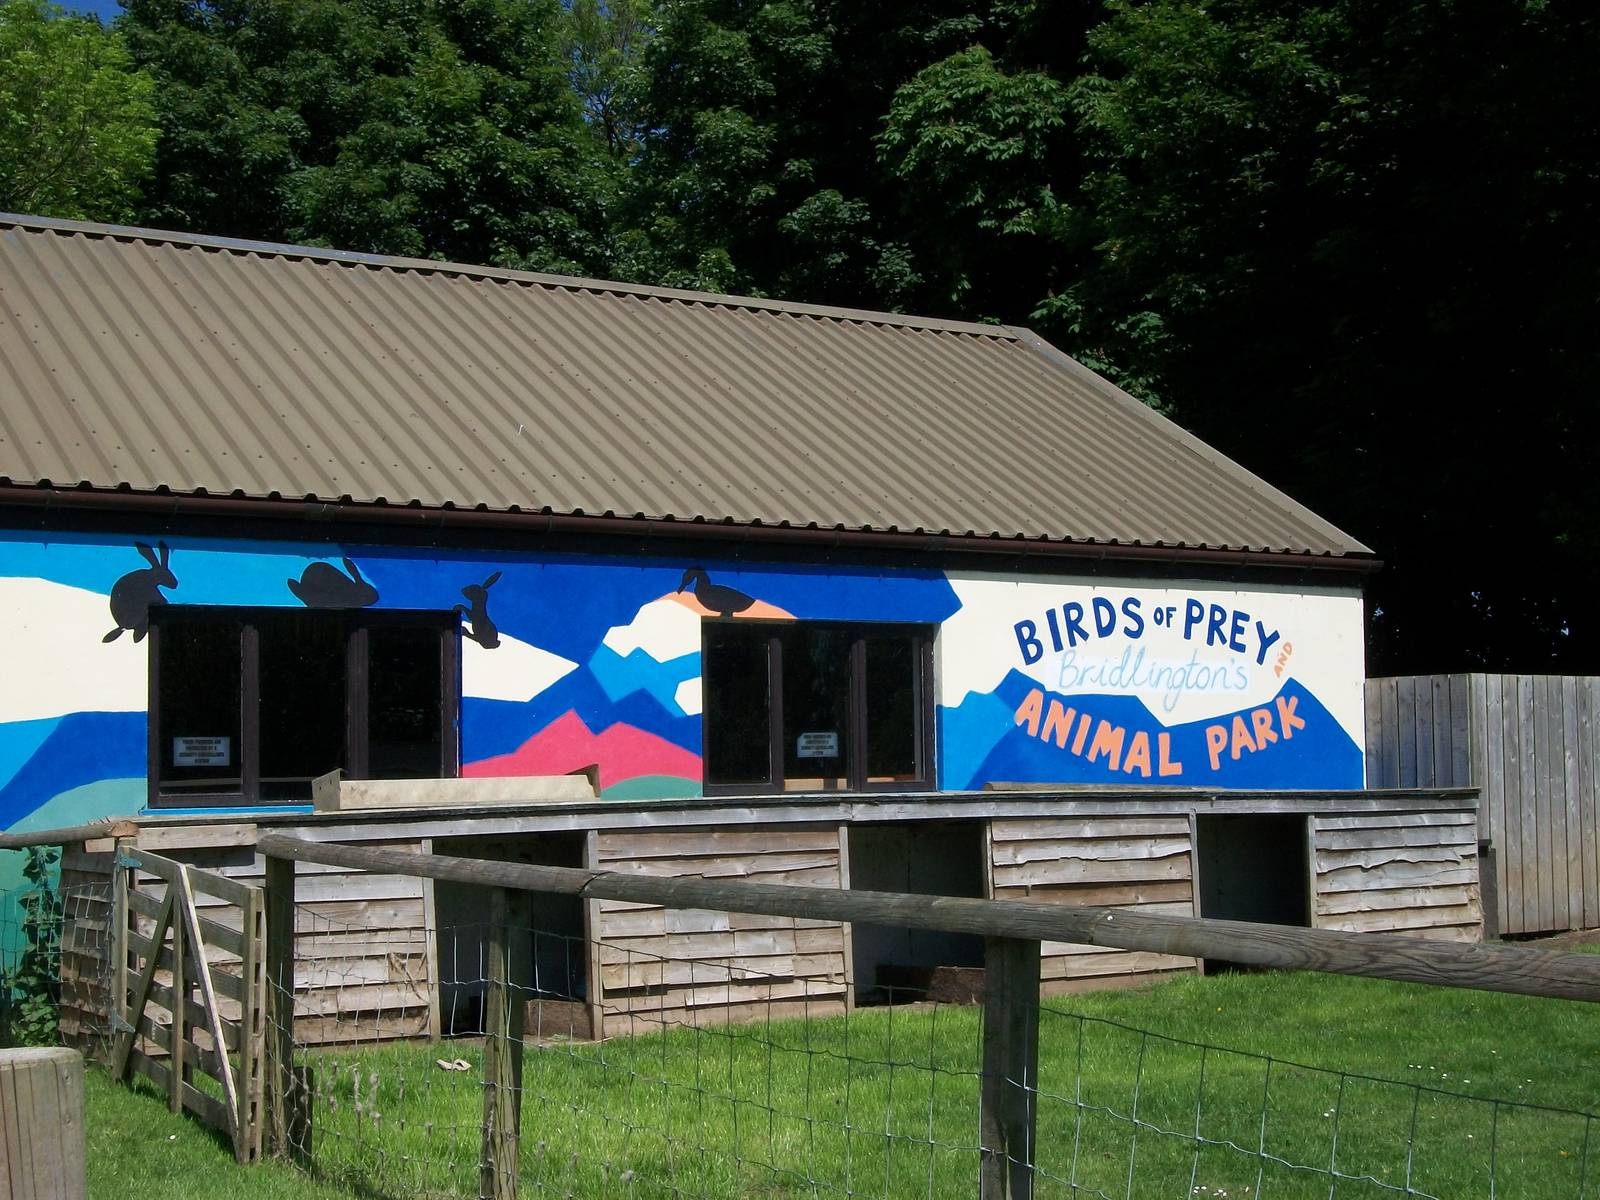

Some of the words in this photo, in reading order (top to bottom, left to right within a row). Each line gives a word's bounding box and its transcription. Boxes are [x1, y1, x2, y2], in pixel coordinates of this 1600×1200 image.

[1014, 597, 1145, 665] BIRDS
[1153, 606, 1177, 628] OF
[1183, 598, 1280, 665] PREY
[1273, 641, 1293, 678] AND
[1058, 644, 1248, 713] Bridlington's
[1014, 688, 1182, 777] ANIMAL
[1205, 695, 1305, 770] PARK
